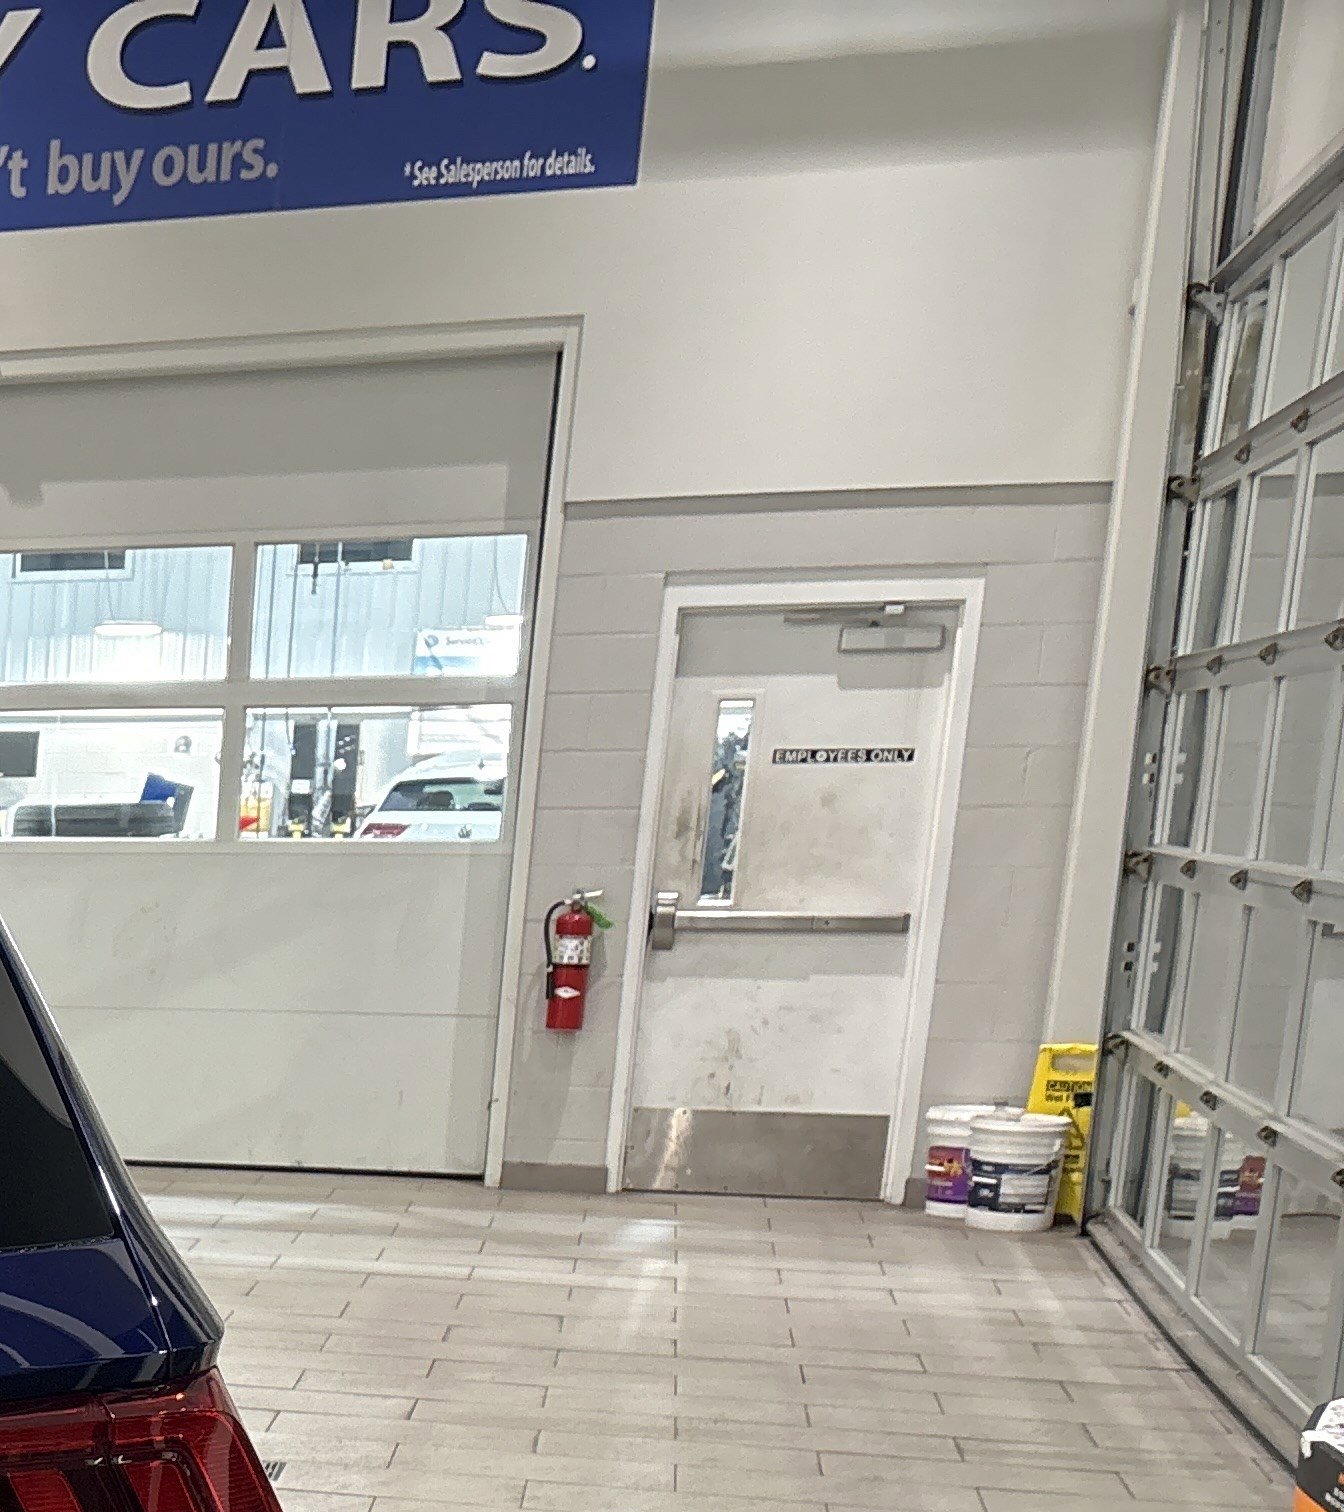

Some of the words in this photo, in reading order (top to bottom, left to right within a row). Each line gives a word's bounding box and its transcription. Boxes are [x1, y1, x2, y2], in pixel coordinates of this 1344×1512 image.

[47, 138, 144, 206] buy
[152, 136, 280, 185] ours.
[439, 155, 521, 190] Salesperson
[522, 149, 545, 178] for
[545, 146, 596, 177] details.
[775, 750, 867, 763] EMPLOYEES
[870, 748, 913, 762] ONLY
